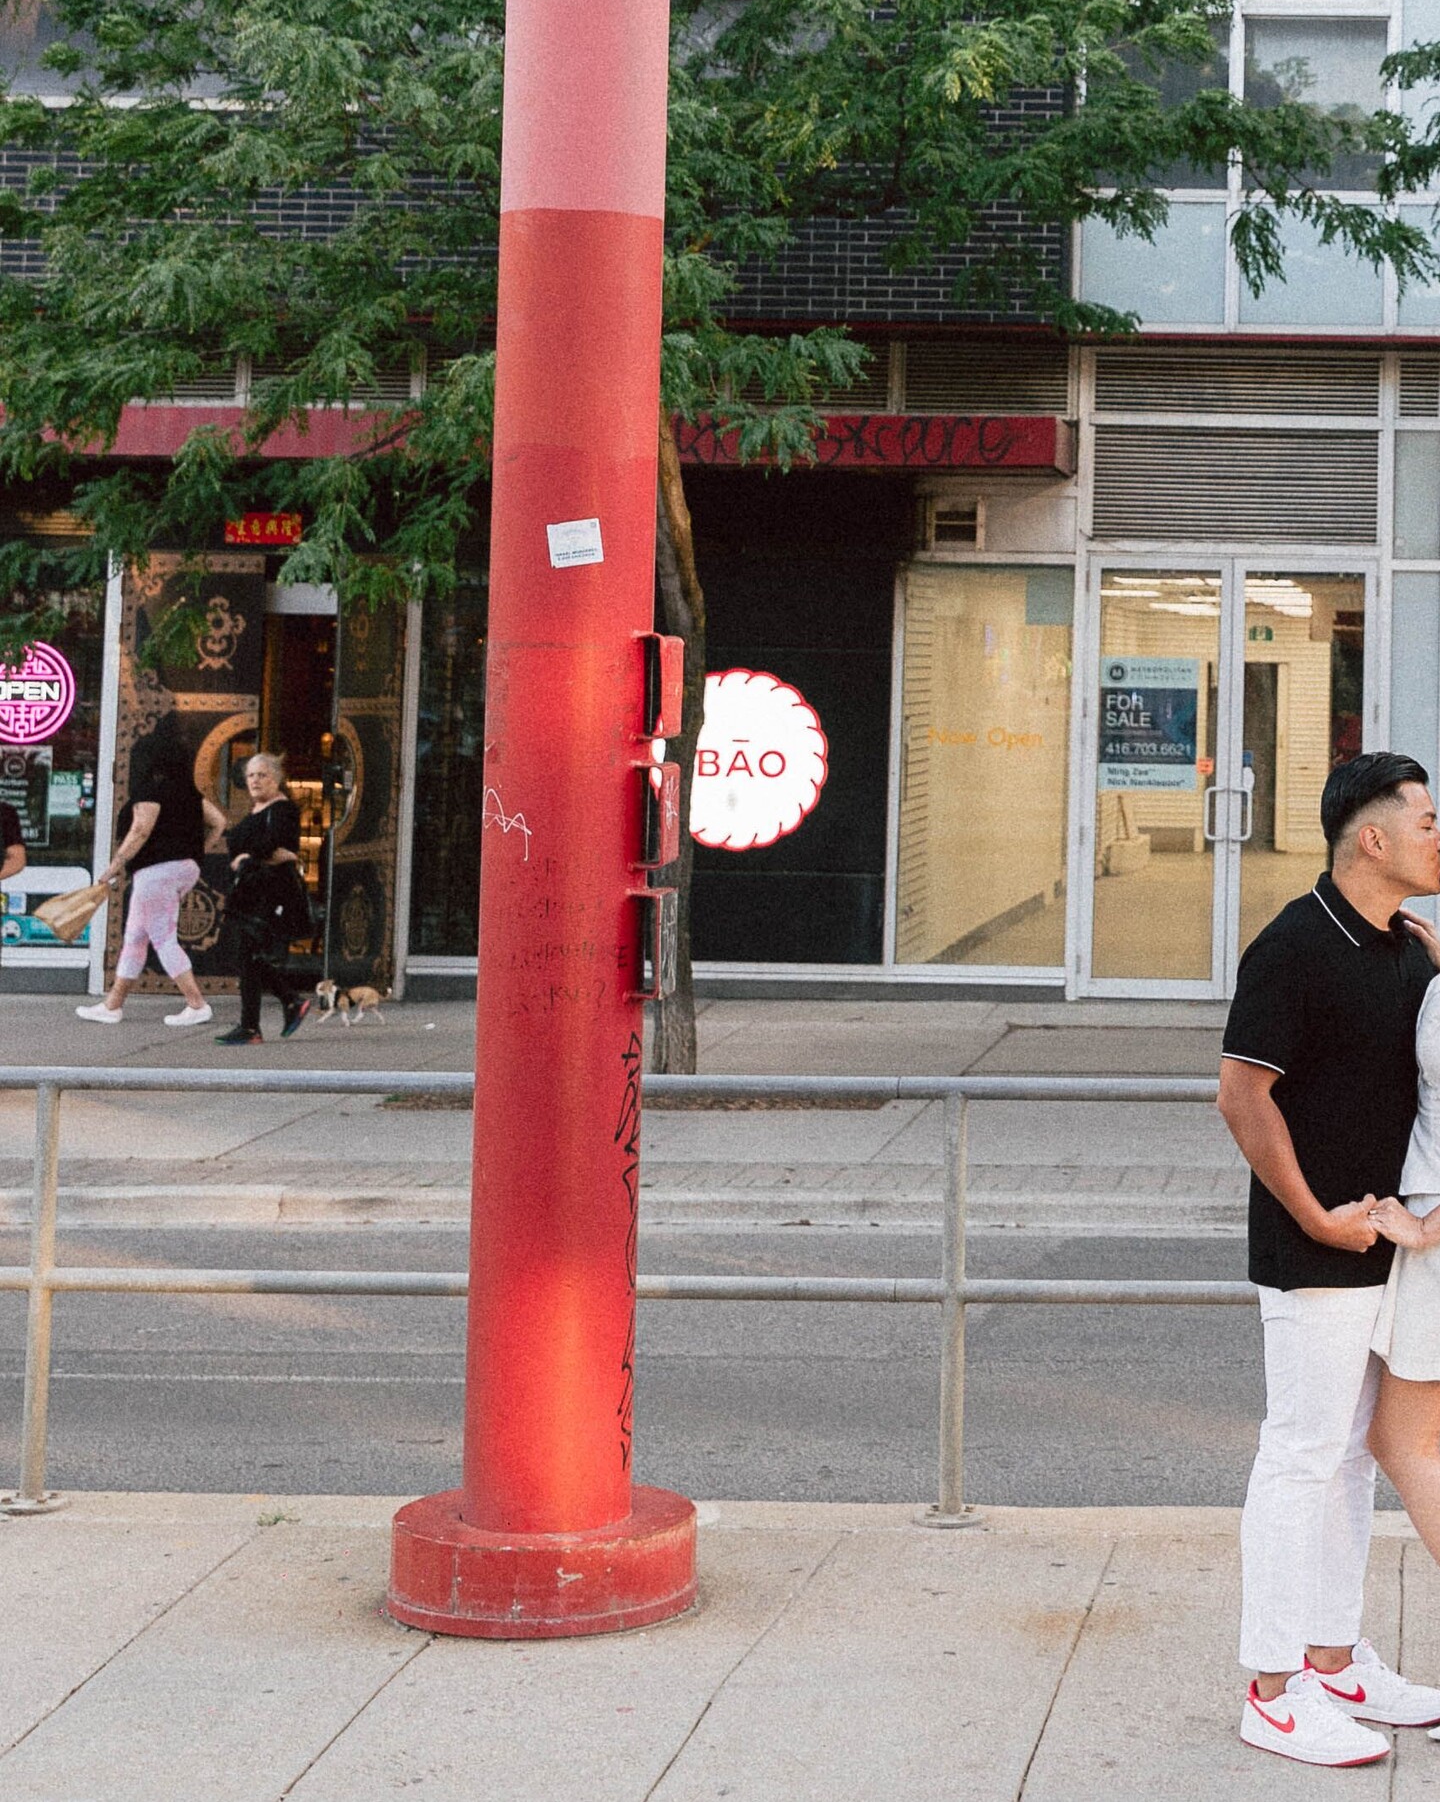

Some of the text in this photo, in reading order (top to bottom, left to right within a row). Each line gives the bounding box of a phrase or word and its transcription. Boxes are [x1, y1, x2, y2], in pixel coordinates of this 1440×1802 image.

[1106, 694, 1144, 711] FOR
[1105, 711, 1152, 728] SALE
[987, 726, 1043, 751] Open
[53, 774, 79, 786] PASS
